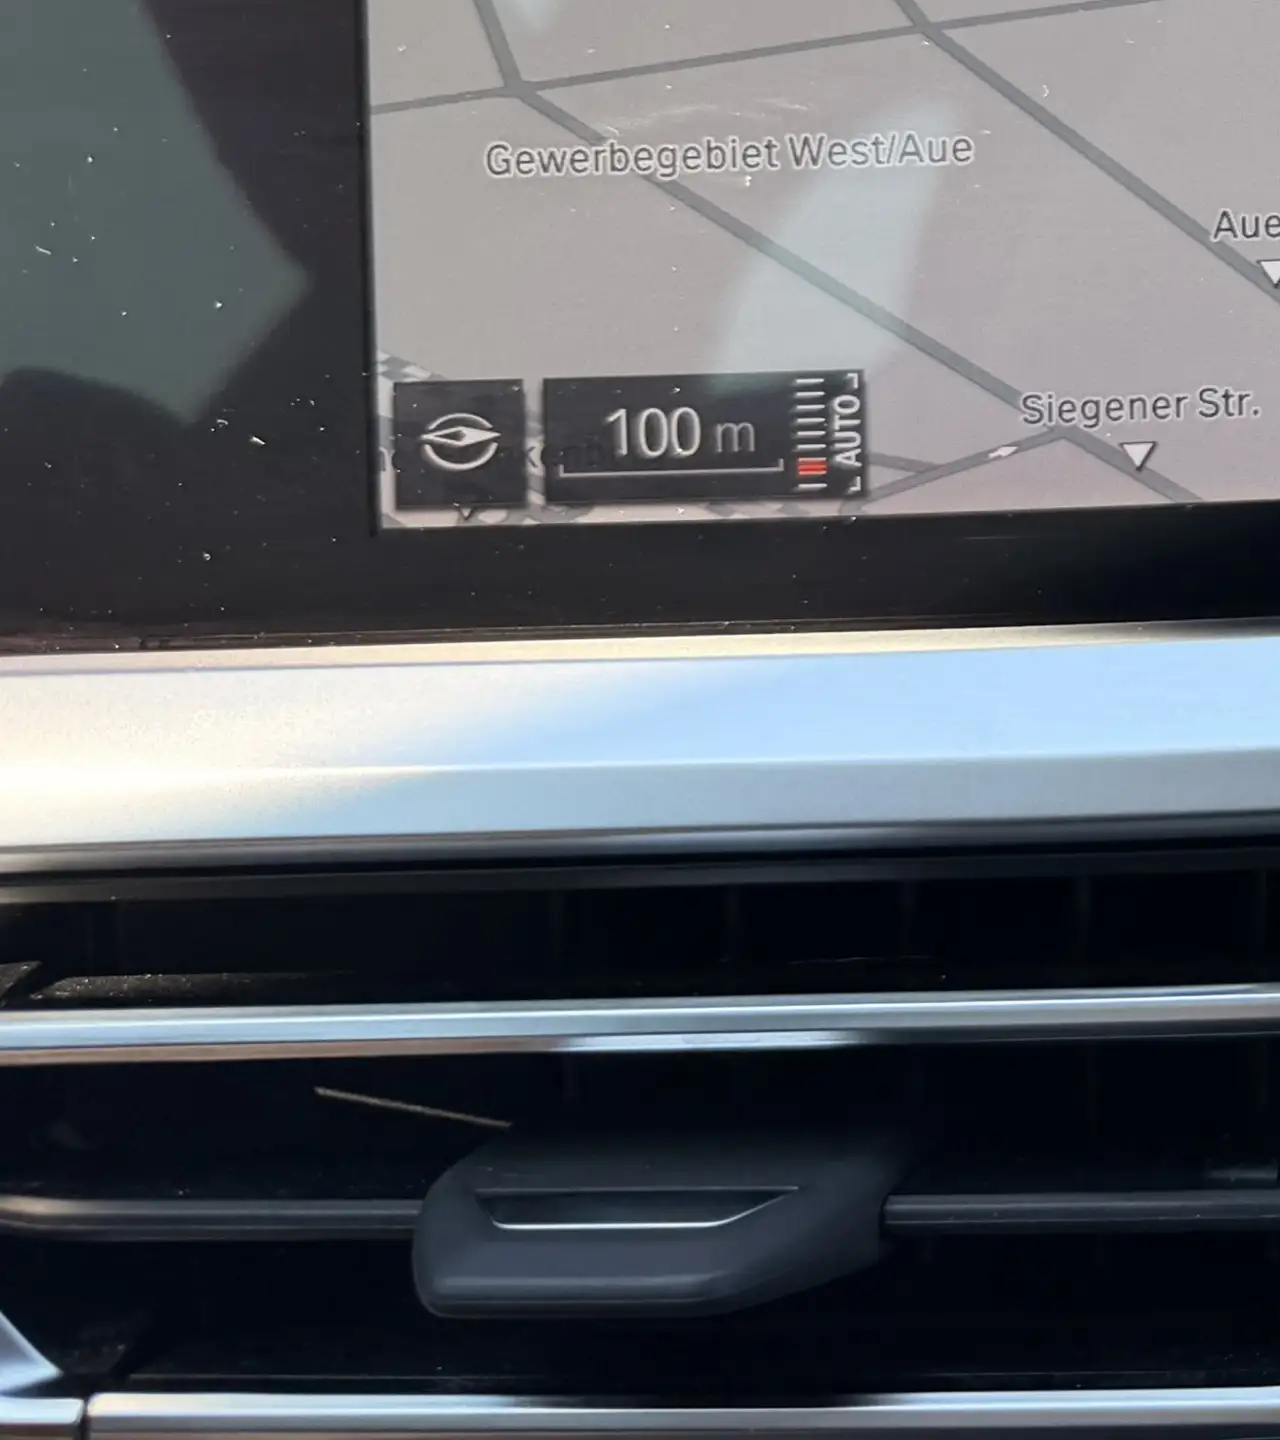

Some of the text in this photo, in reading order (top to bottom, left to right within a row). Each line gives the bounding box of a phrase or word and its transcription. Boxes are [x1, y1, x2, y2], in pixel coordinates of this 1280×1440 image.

[485, 132, 974, 178] Gewerbegebiet West/Aue
[833, 394, 862, 468] AUTO
[1021, 388, 1261, 428] Siegener Str.
[607, 407, 756, 459] 100 m
